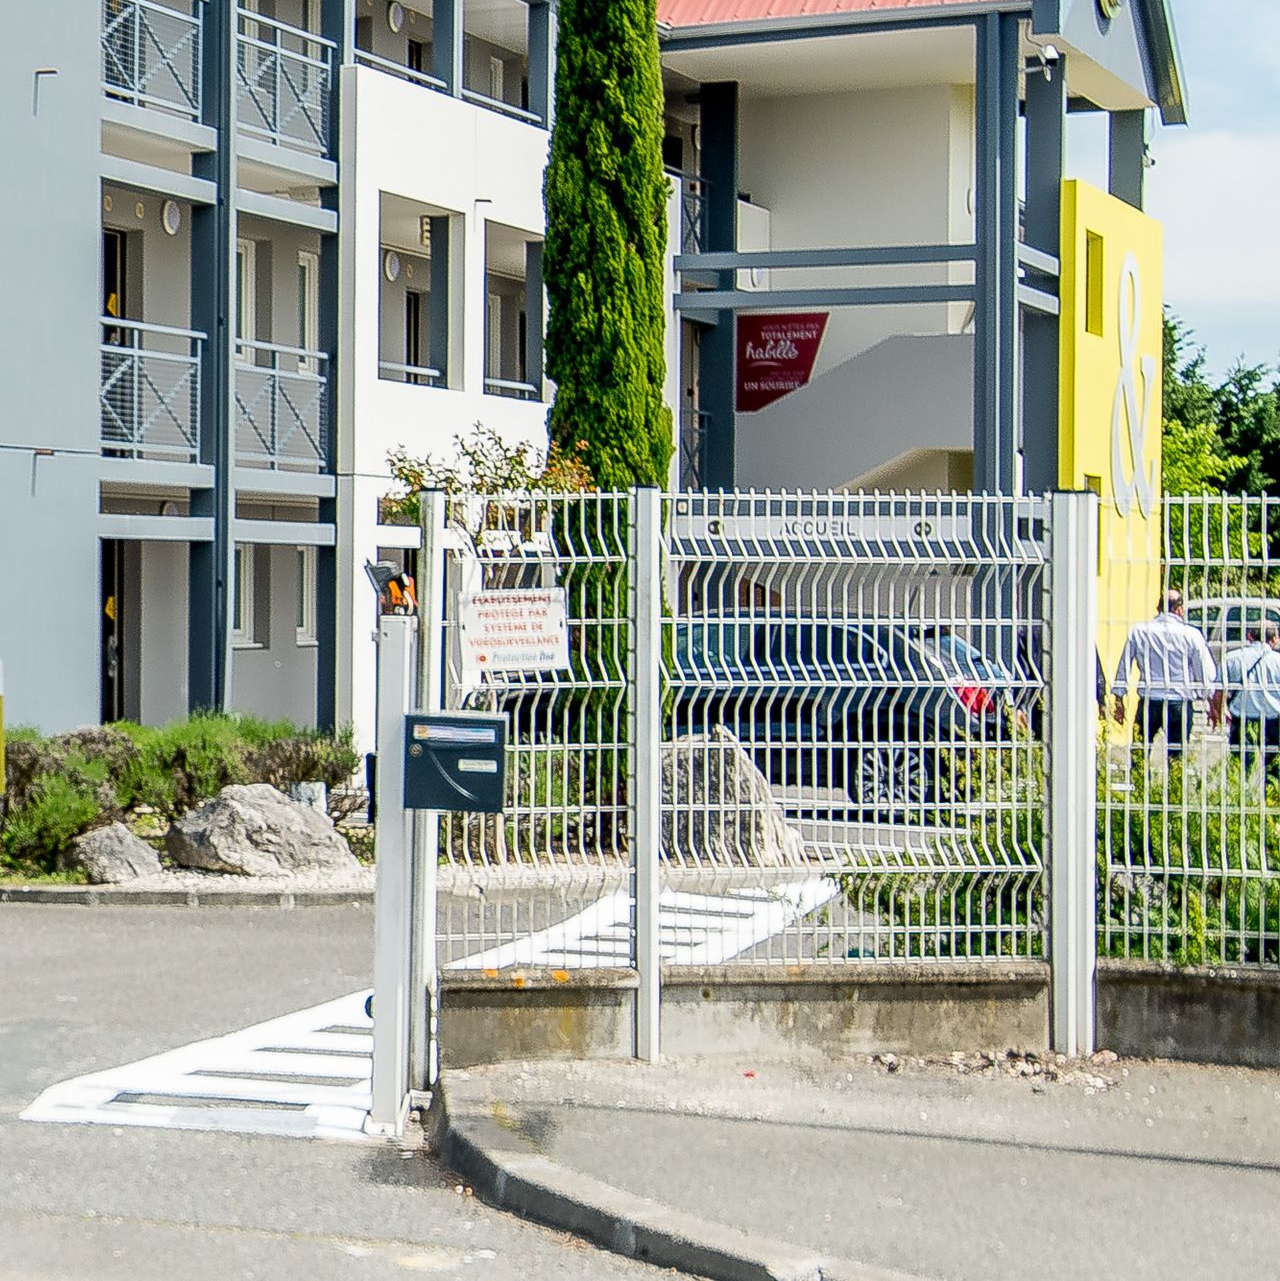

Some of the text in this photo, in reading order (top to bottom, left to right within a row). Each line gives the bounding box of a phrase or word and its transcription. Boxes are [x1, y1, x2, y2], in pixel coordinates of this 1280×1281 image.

[761, 330, 818, 340] TOTALEMENT
[779, 520, 856, 537] ACCUEIL
[528, 607, 548, 618] PAR
[531, 622, 544, 632] DE
